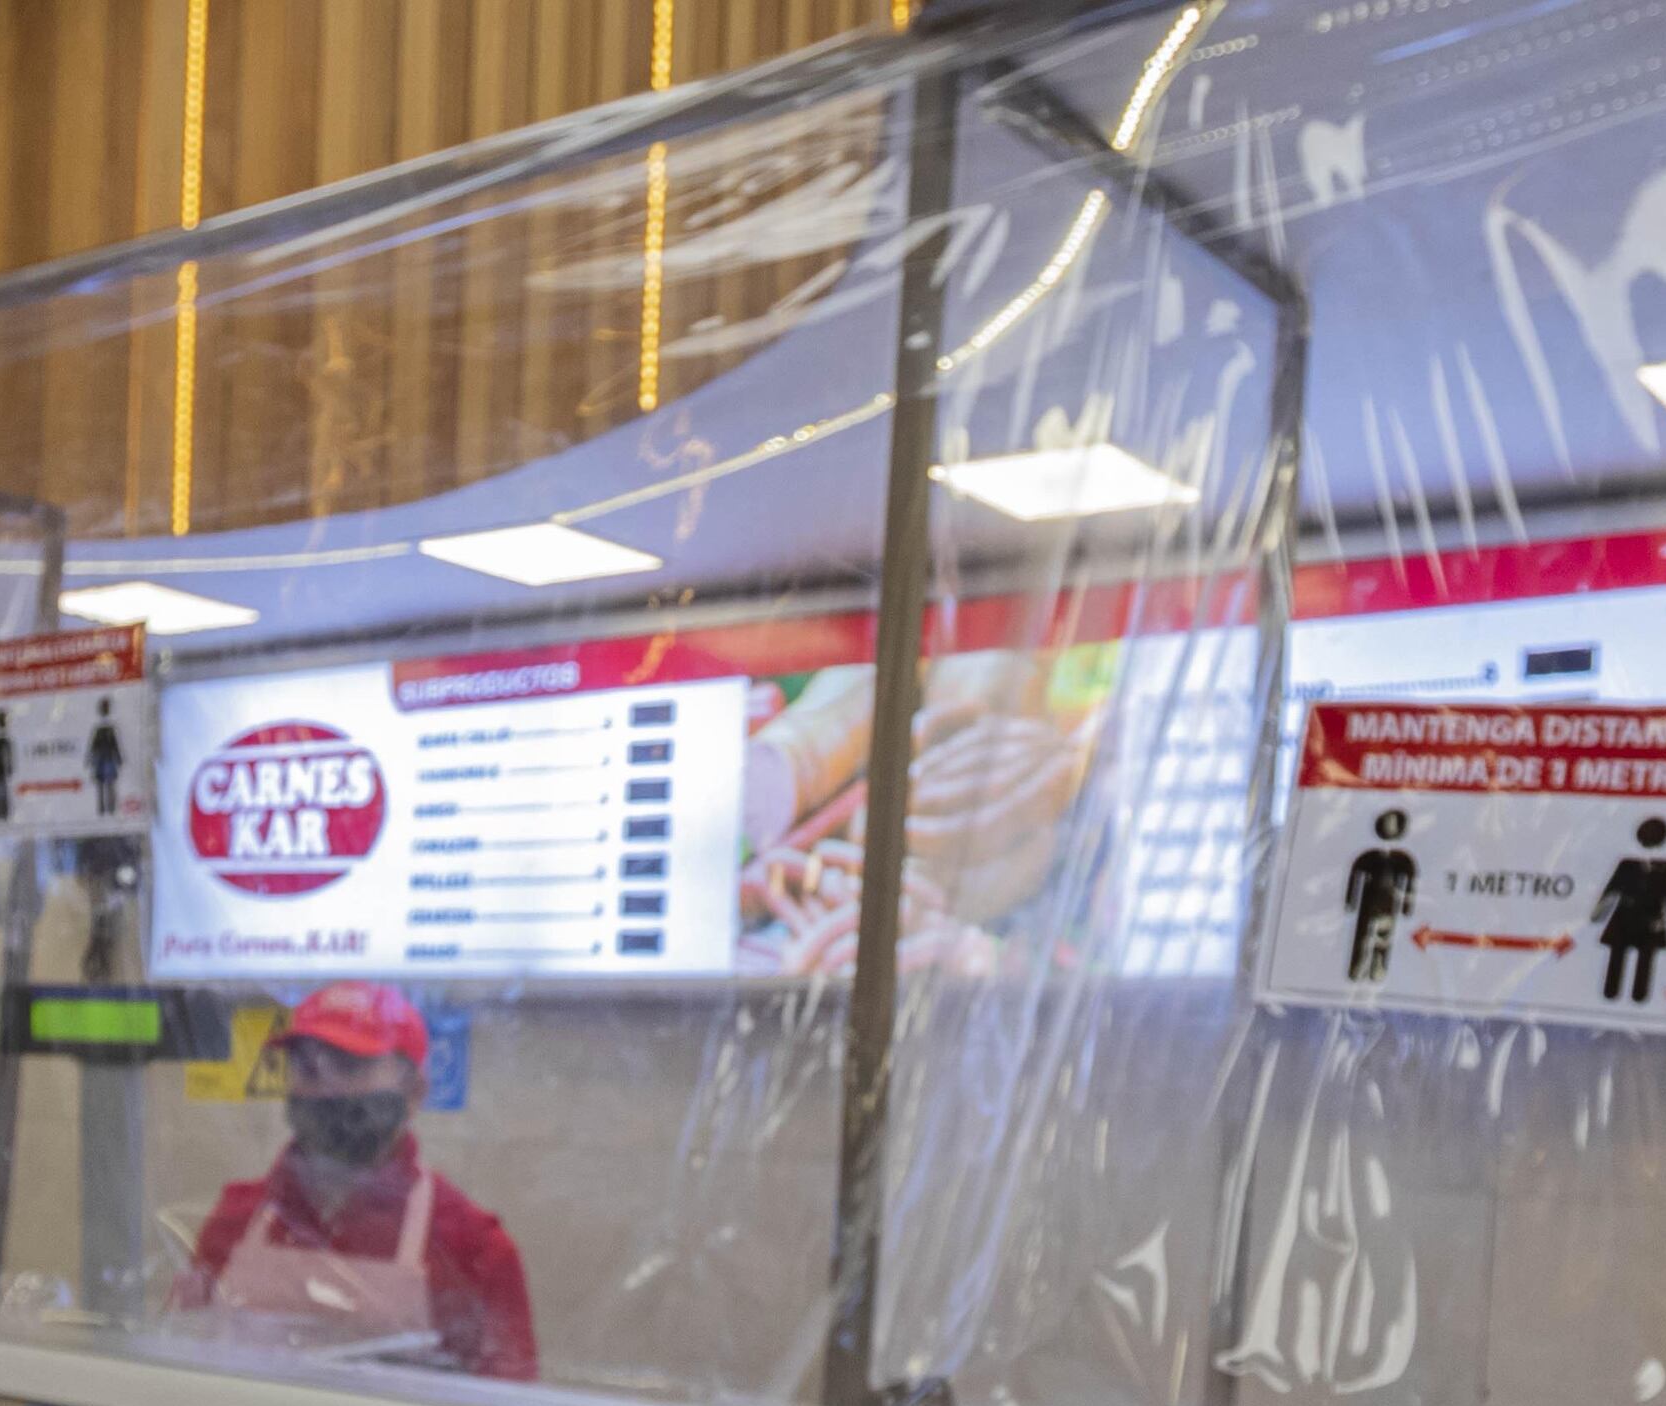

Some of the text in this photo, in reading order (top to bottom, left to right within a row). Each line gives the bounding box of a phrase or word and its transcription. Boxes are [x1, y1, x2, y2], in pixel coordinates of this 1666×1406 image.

[1346, 712, 1536, 746] MANTENGA
[194, 753, 376, 815] CARNES
[1361, 749, 1490, 784] MÍNIMA
[1496, 755, 1543, 787] DE
[1550, 757, 1568, 788] 1
[231, 809, 331, 857] KAR
[1444, 870, 1576, 899] 1 METRO
